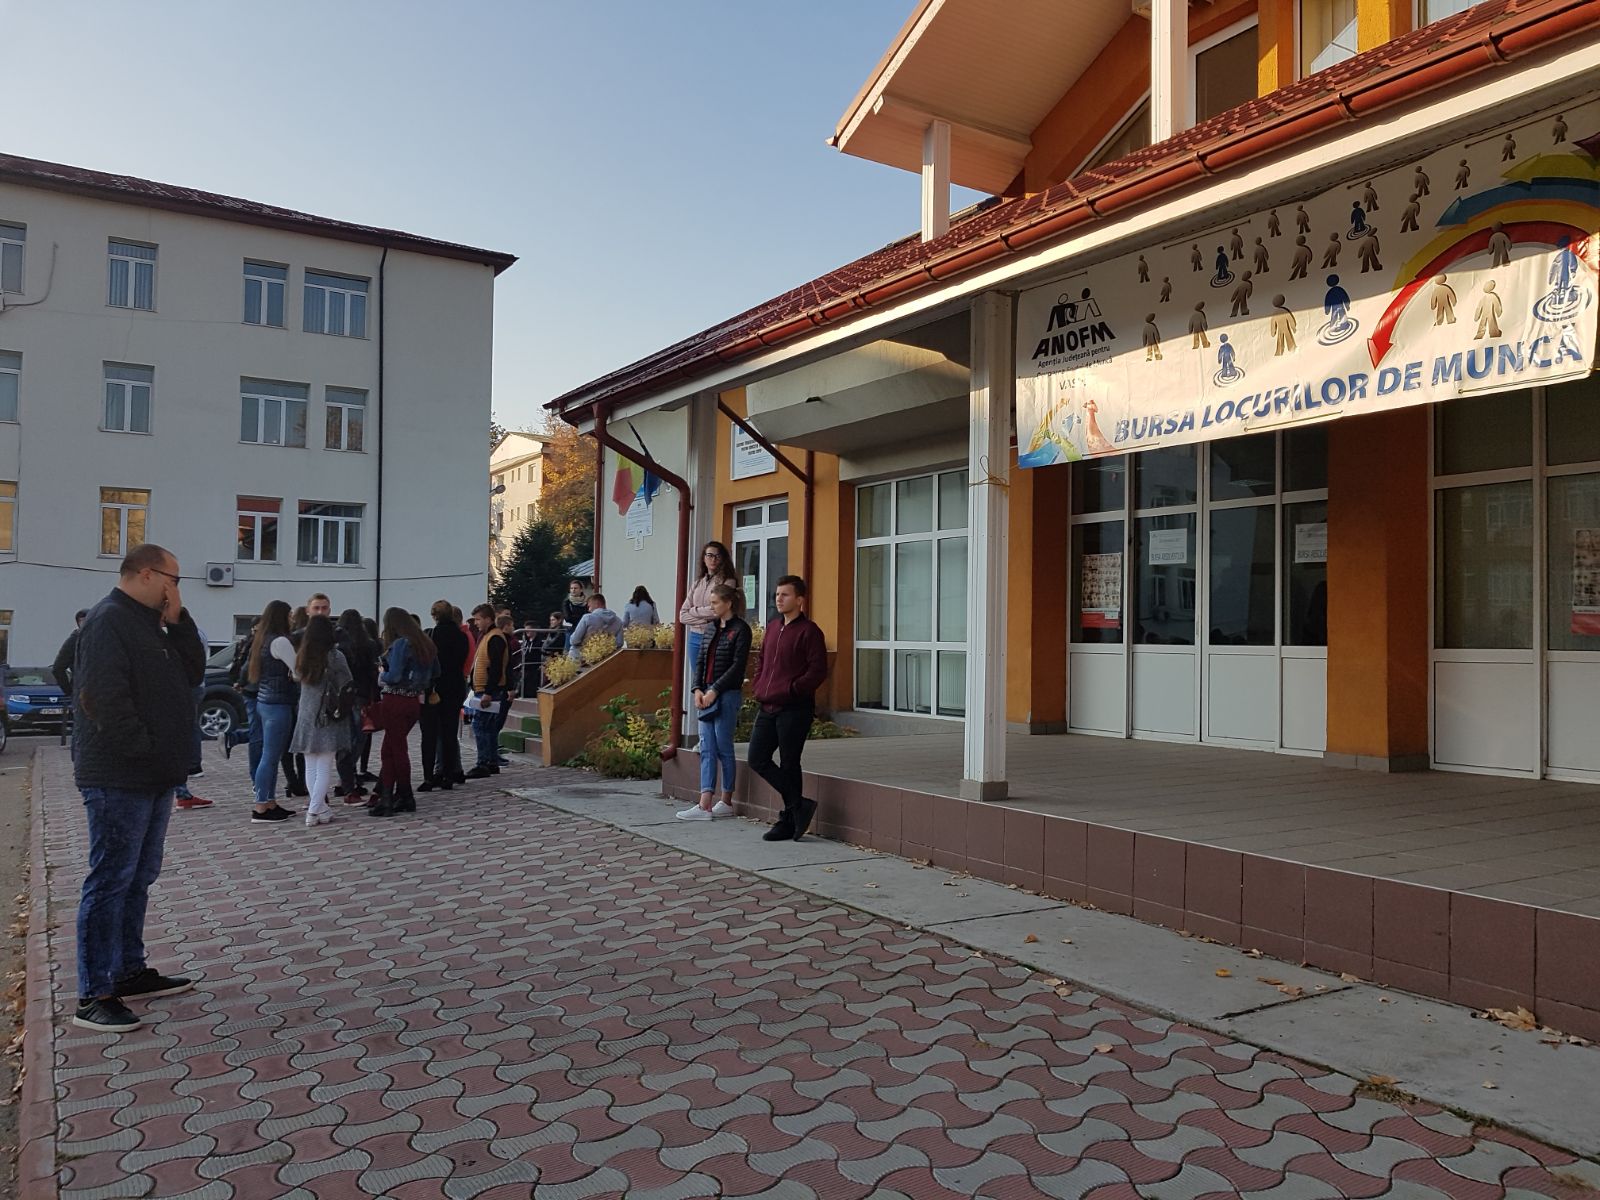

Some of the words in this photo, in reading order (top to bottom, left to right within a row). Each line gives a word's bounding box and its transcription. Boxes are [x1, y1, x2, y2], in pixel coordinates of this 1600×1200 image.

[1032, 321, 1117, 360] ANOFM
[1091, 345, 1110, 357] pentru
[1115, 408, 1195, 443] BURSA
[1201, 373, 1369, 429] LOCURILOR
[1377, 361, 1423, 396] DE
